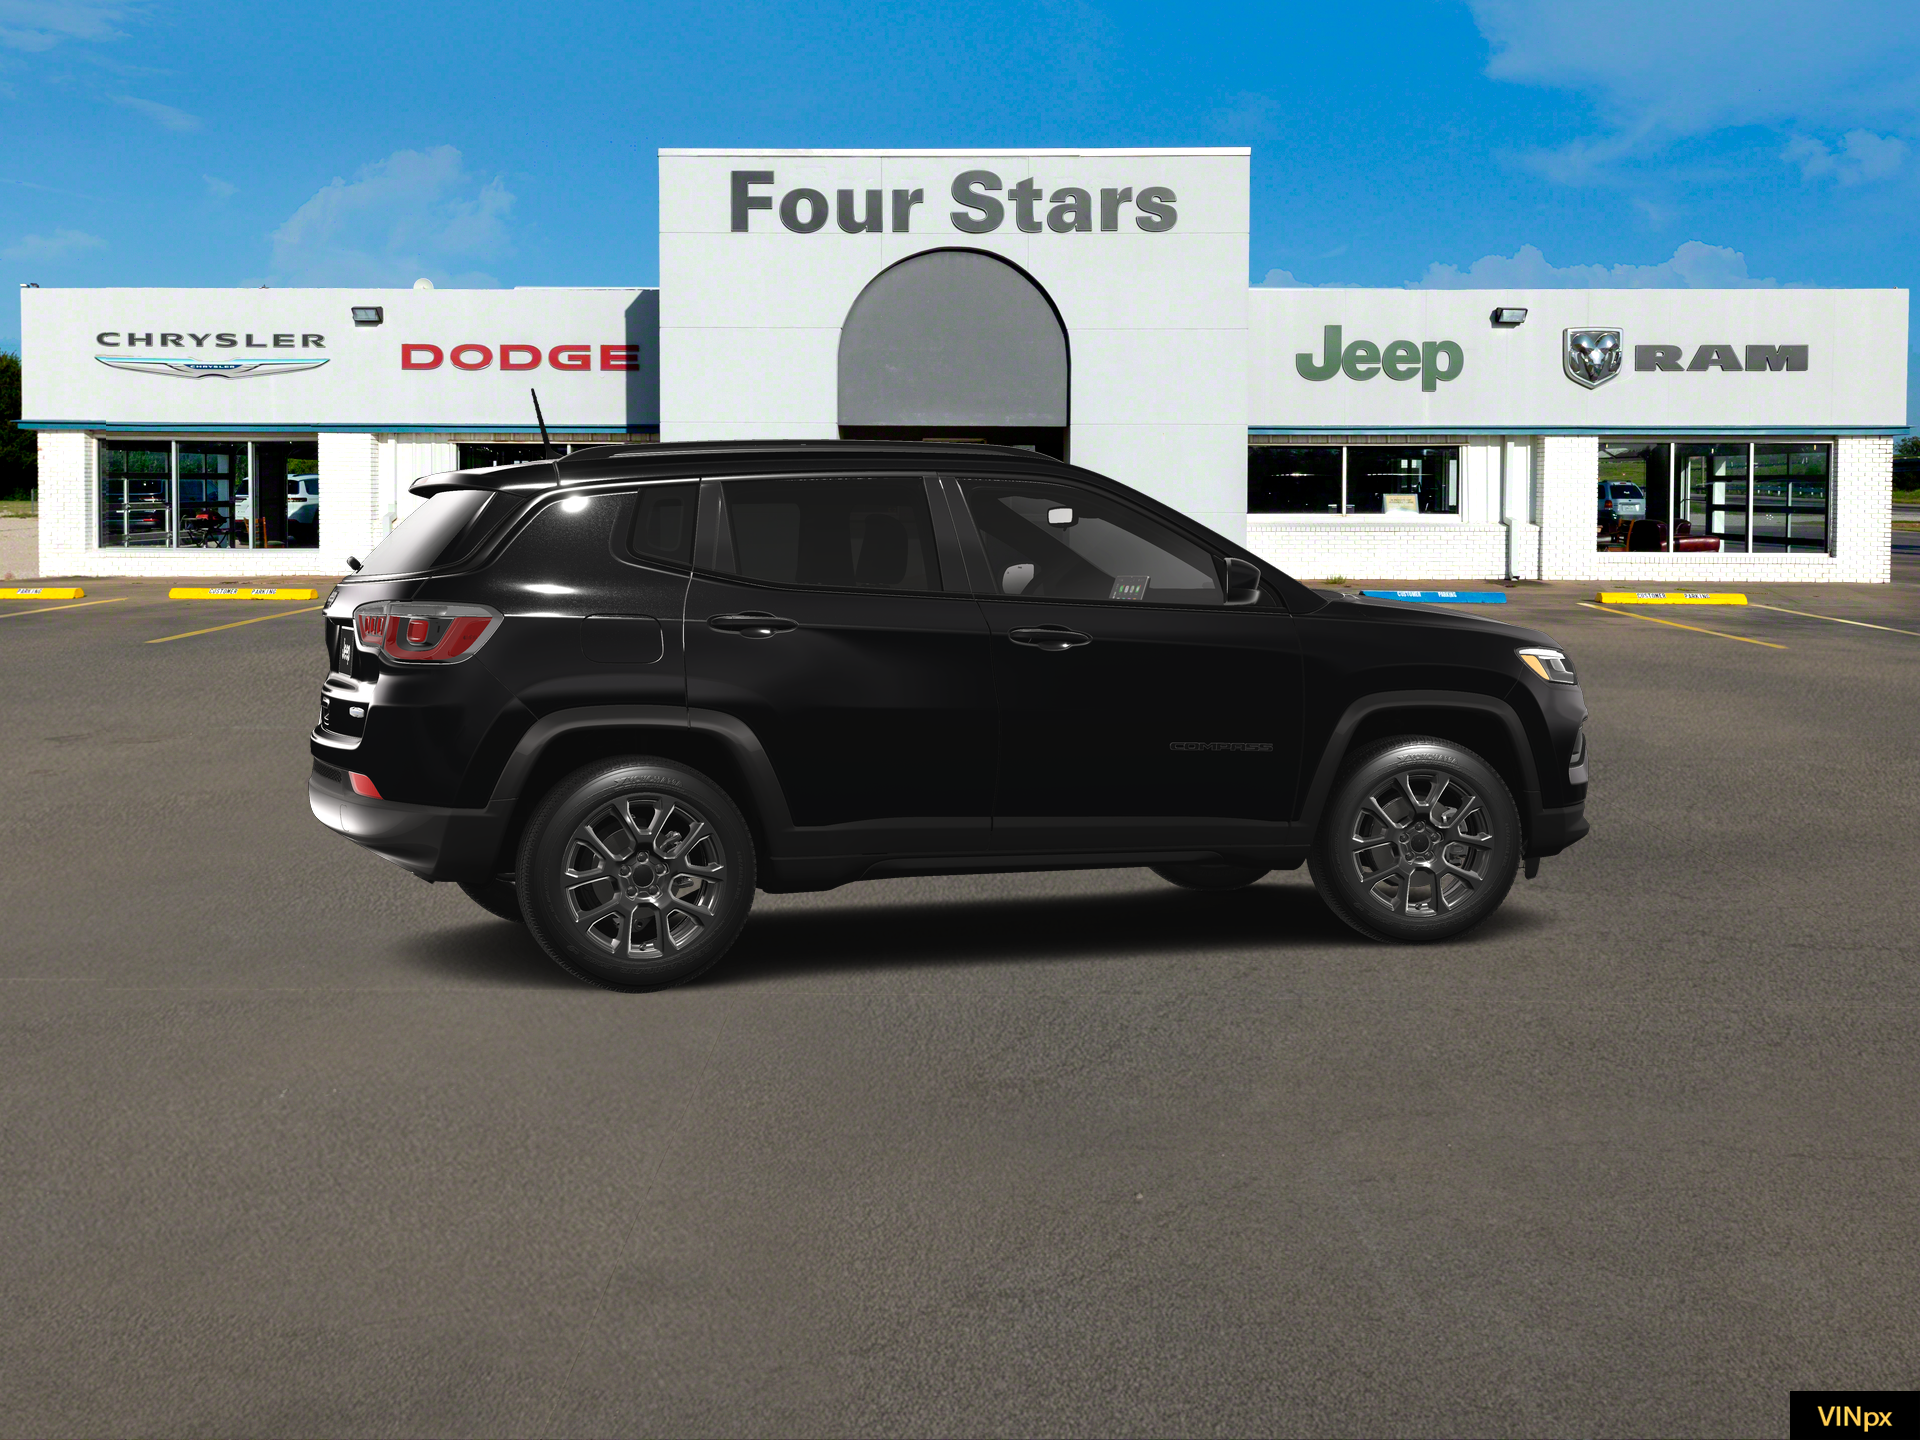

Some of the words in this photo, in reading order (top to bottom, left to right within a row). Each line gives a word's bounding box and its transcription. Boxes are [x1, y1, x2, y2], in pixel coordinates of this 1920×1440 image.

[730, 170, 925, 234] Four
[950, 169, 1178, 234] Stars
[96, 331, 327, 348] CHRYSLER
[401, 343, 640, 371] DODGE
[1295, 324, 1465, 392] Jeep
[1635, 344, 1809, 372] RAM
[1169, 742, 1273, 752] COMPASS
